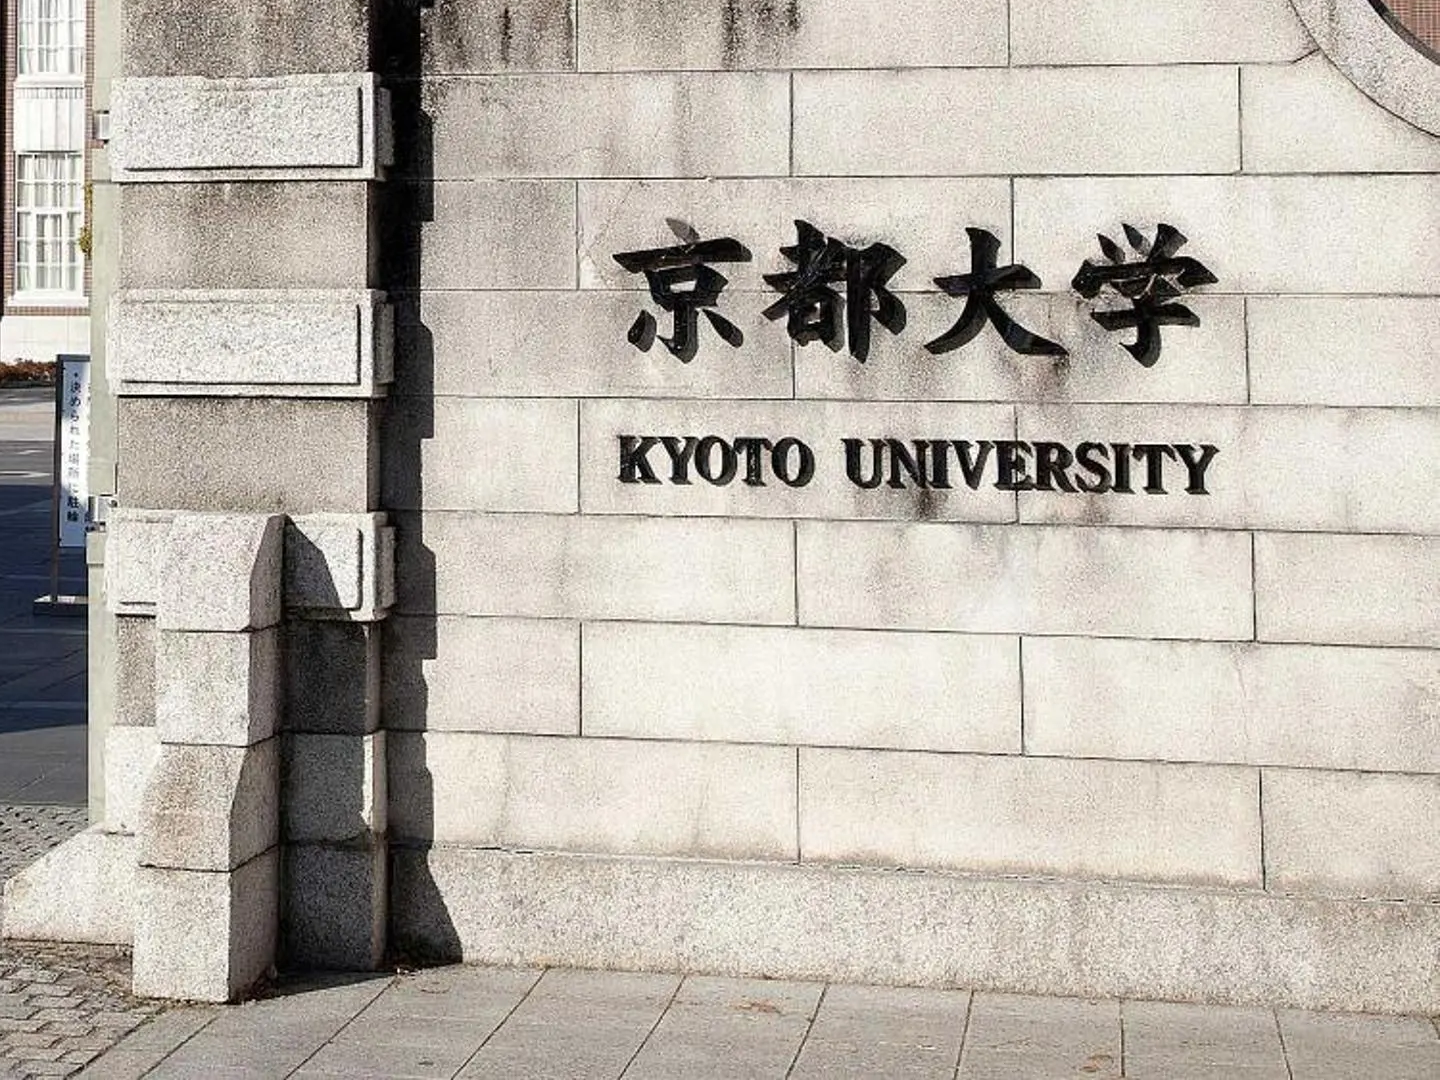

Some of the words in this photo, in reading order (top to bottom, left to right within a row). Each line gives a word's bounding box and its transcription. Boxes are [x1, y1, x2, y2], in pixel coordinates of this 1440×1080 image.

[612, 218, 1219, 368] 京都大学
[615, 434, 816, 489] KYOTO
[841, 437, 1220, 495] UNIVERSITY
